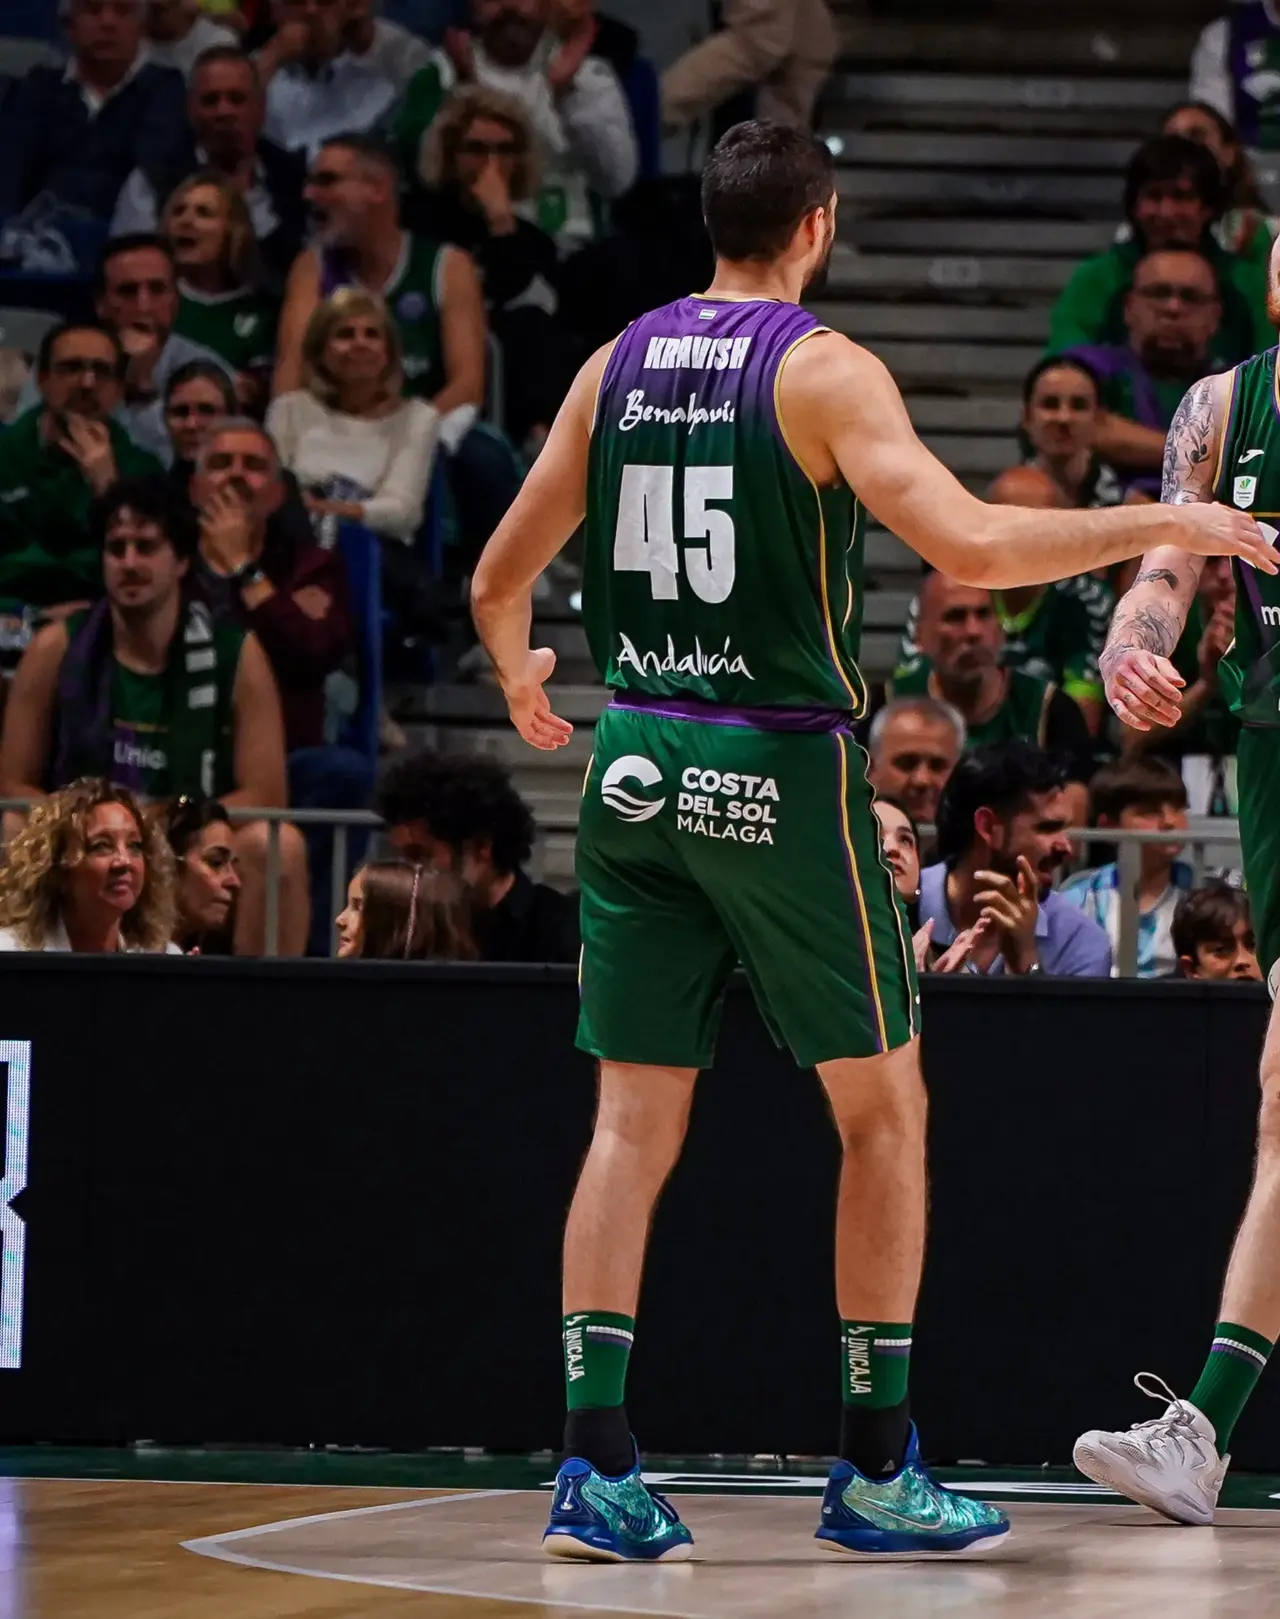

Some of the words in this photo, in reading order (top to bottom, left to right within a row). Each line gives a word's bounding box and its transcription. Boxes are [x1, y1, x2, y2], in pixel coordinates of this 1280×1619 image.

[643, 336, 751, 370] KRAVISH
[614, 465, 735, 604] 45
[616, 632, 755, 681] Andalucía
[681, 766, 780, 801] COSTA
[677, 792, 721, 817] DEL
[726, 801, 777, 824] SOL
[677, 814, 774, 845] MÁLAGA
[566, 1327, 585, 1382] UNICAJA
[848, 1336, 872, 1393] UNICAJA
